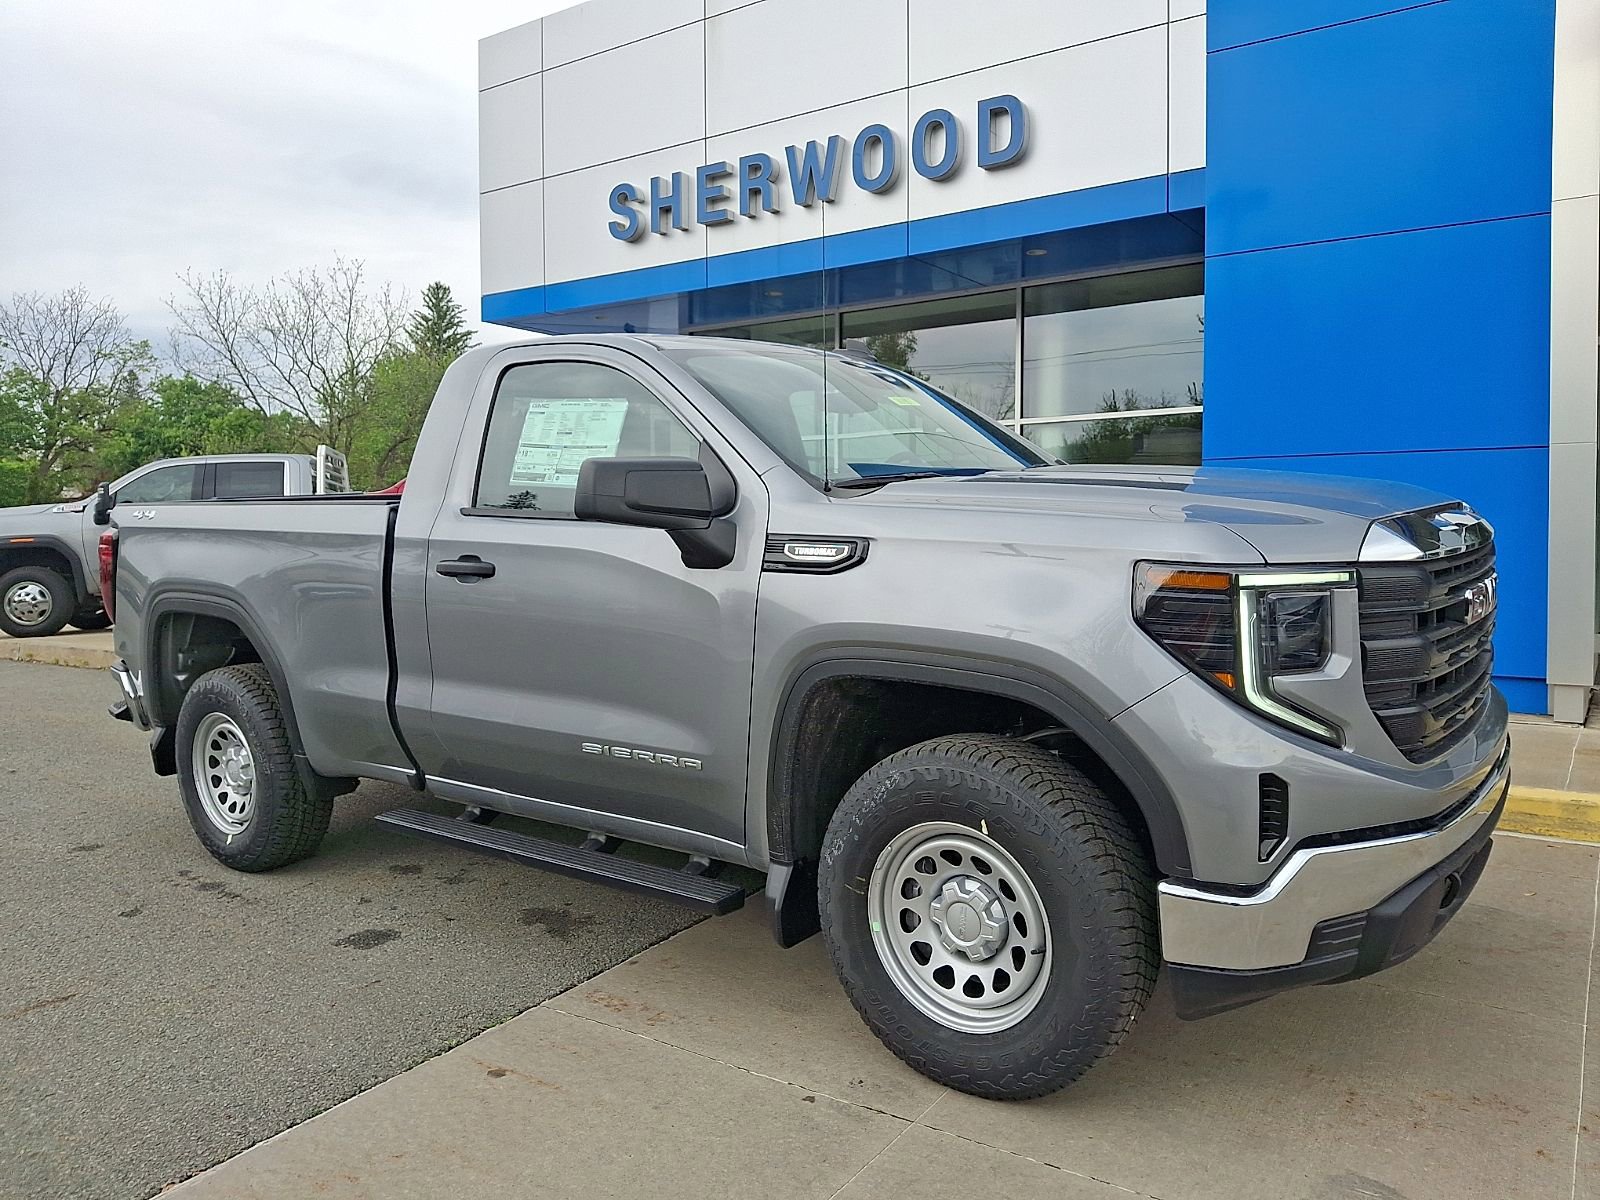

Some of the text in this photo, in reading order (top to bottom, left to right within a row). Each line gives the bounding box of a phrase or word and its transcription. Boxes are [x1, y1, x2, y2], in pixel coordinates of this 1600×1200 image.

[607, 94, 1029, 242] SHERWOOD
[794, 547, 837, 556] TURBOMAX
[581, 741, 703, 771] SIERRA
